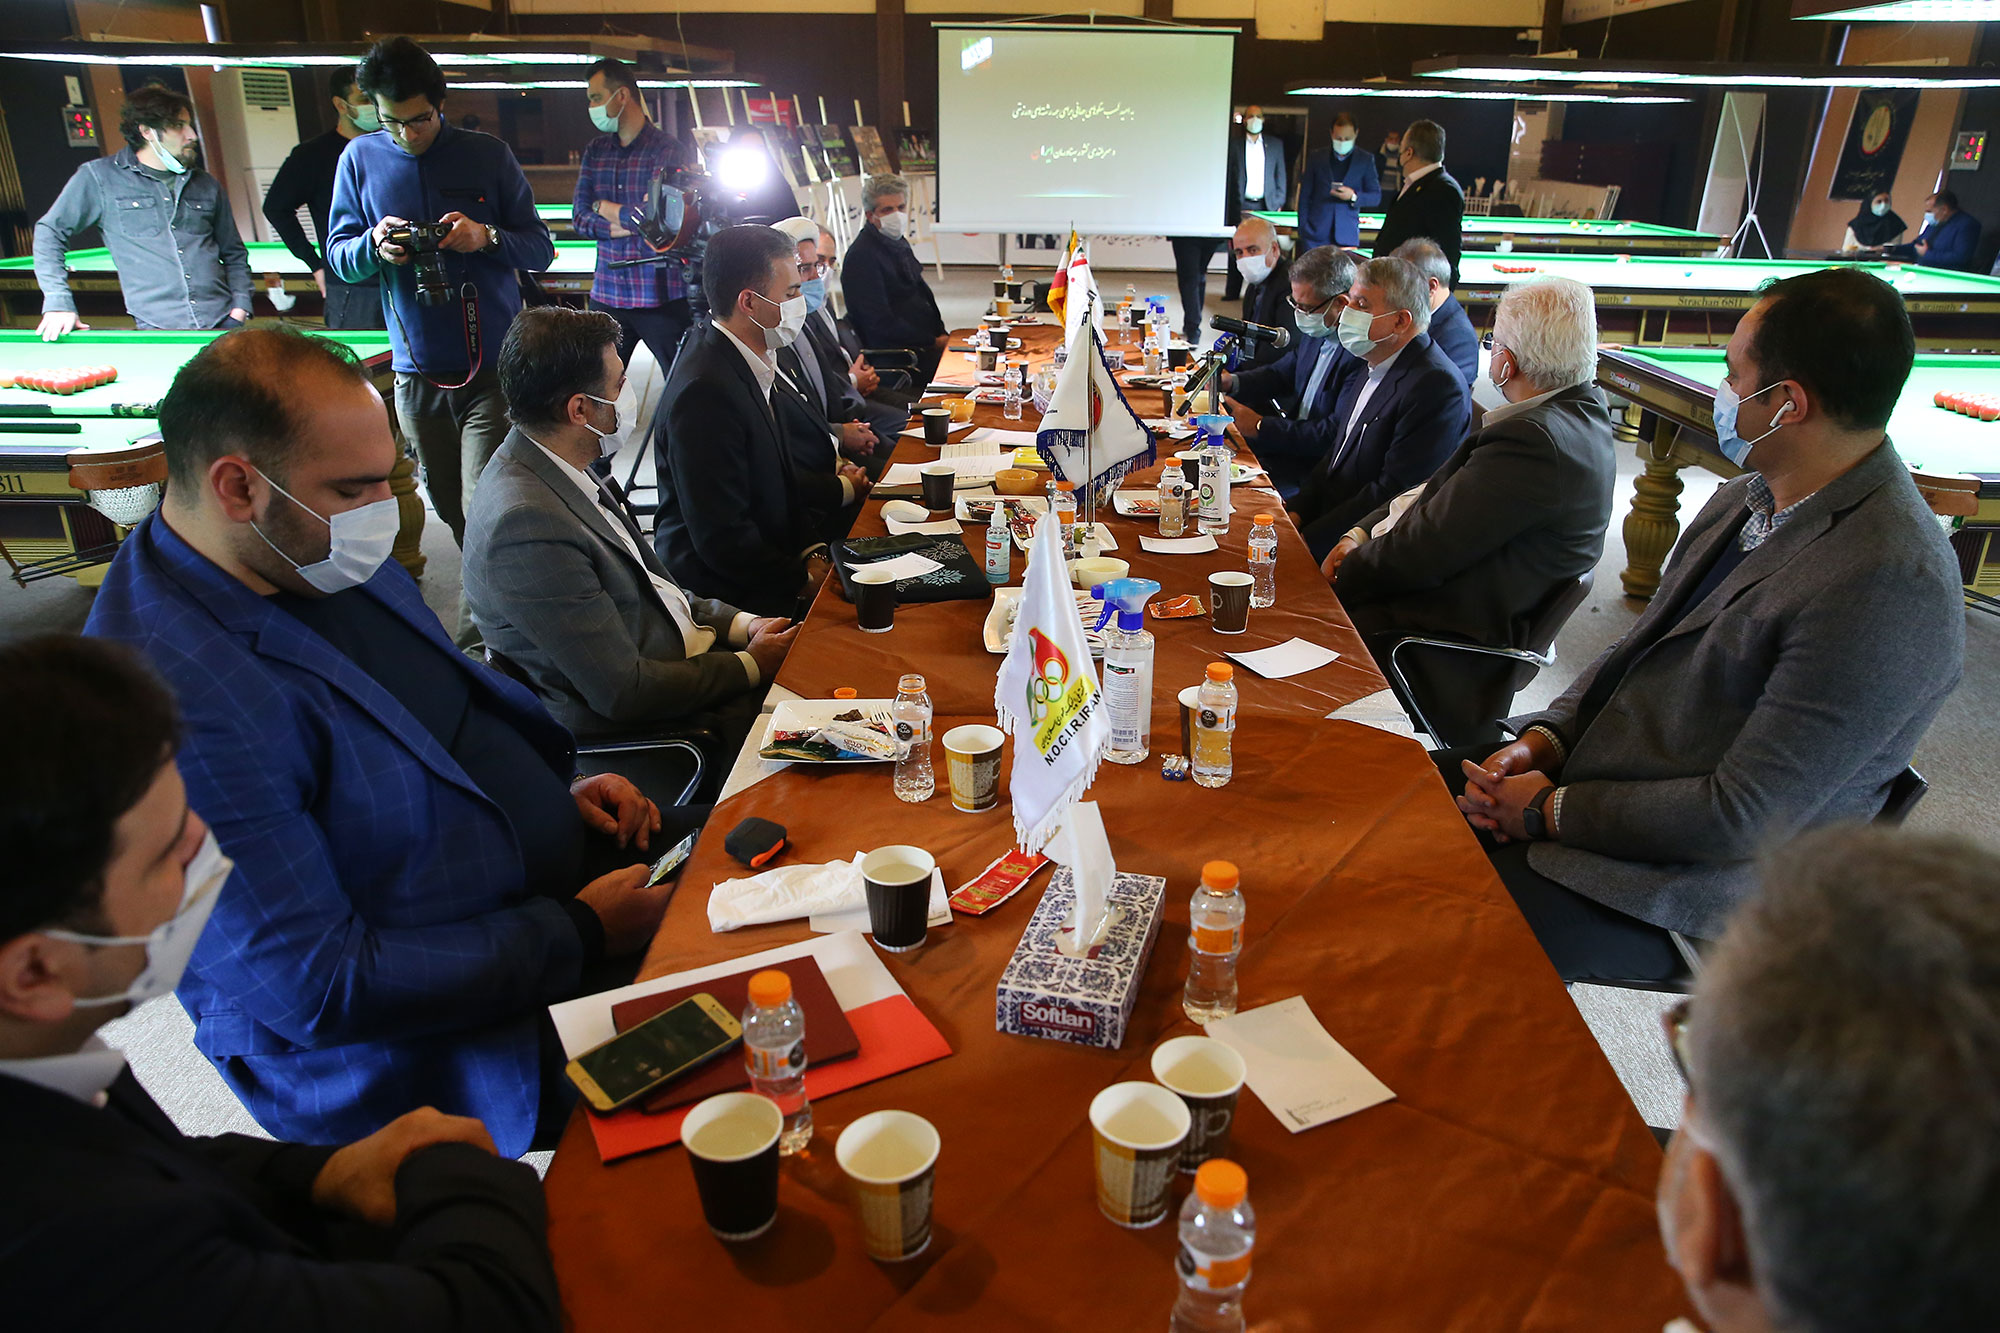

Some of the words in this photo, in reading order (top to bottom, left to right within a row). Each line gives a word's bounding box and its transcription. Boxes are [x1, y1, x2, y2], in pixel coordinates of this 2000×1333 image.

[466, 302, 477, 322] EOS
[1677, 295, 1719, 307] Strachan
[1044, 689, 1101, 767] N.O.C.I.R.IRAN
[1021, 1002, 1093, 1030] Softlan
